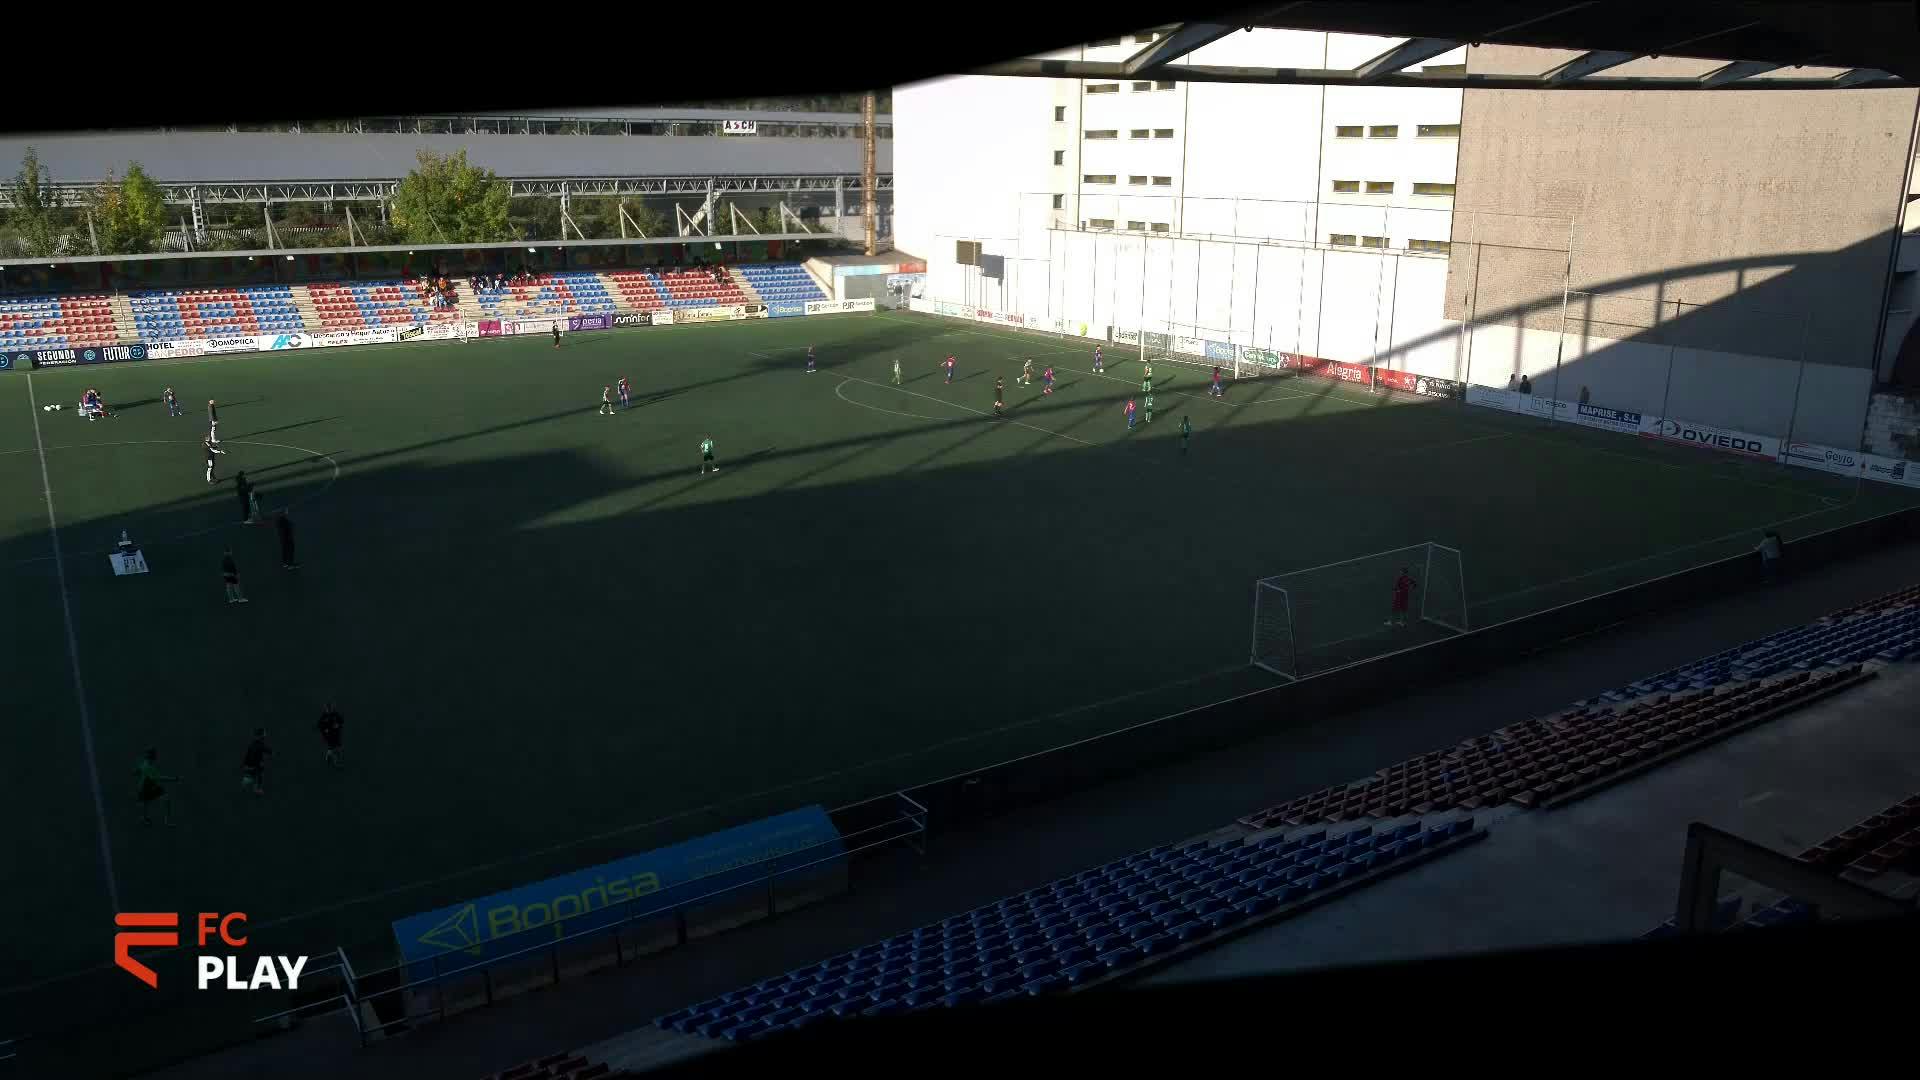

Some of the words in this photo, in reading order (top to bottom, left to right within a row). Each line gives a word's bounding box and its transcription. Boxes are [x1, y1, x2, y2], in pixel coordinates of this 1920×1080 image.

[147, 342, 174, 350] HOTEL
[37, 349, 76, 361] SEGUNDA
[1682, 429, 1762, 453] OVIEDO
